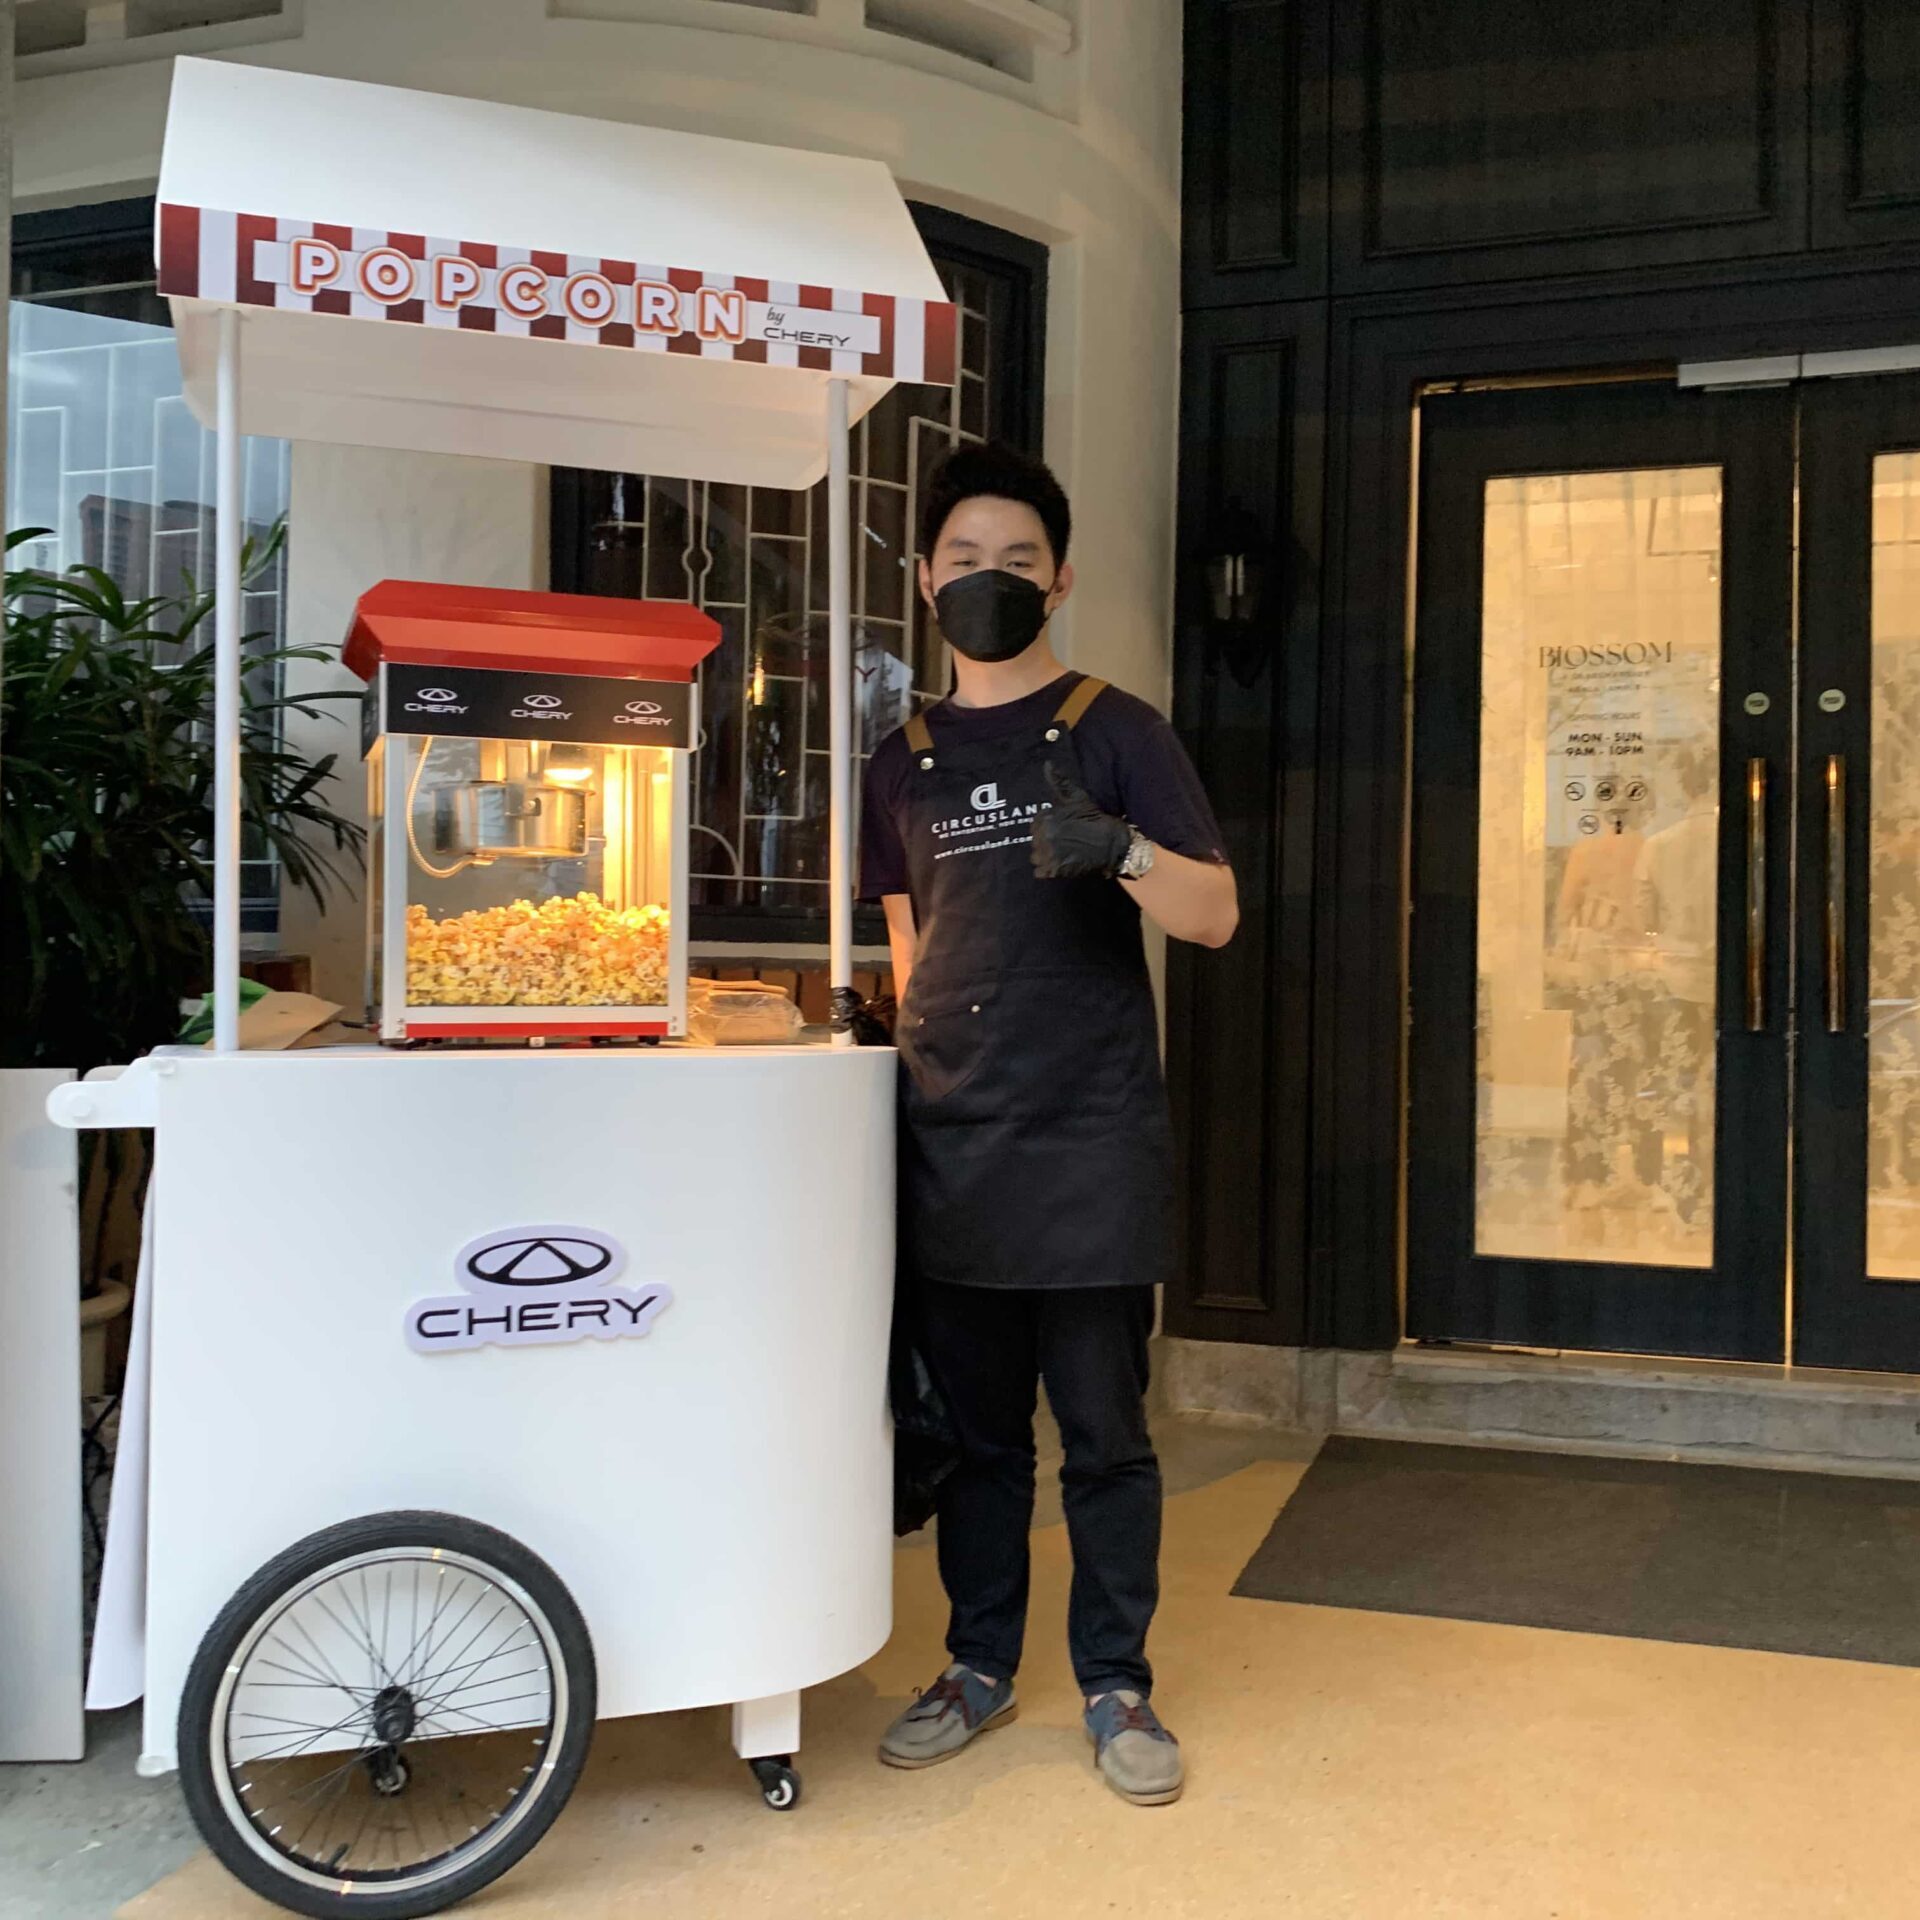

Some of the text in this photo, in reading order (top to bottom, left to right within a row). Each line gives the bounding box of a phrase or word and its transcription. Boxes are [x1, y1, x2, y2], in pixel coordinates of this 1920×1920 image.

[291, 238, 746, 342] POPCORN
[766, 306, 785, 325] by
[763, 326, 851, 348] CHERY
[1539, 641, 1672, 669] BLOSSOM
[403, 702, 470, 715] CHERY
[510, 708, 574, 720] CHERY
[612, 714, 673, 726] CHERY
[1568, 732, 1602, 742] MON
[1614, 732, 1642, 742] SUN
[1564, 746, 1596, 756] 9AM
[1609, 746, 1644, 756] 10PM
[416, 1295, 658, 1339] CHERY
